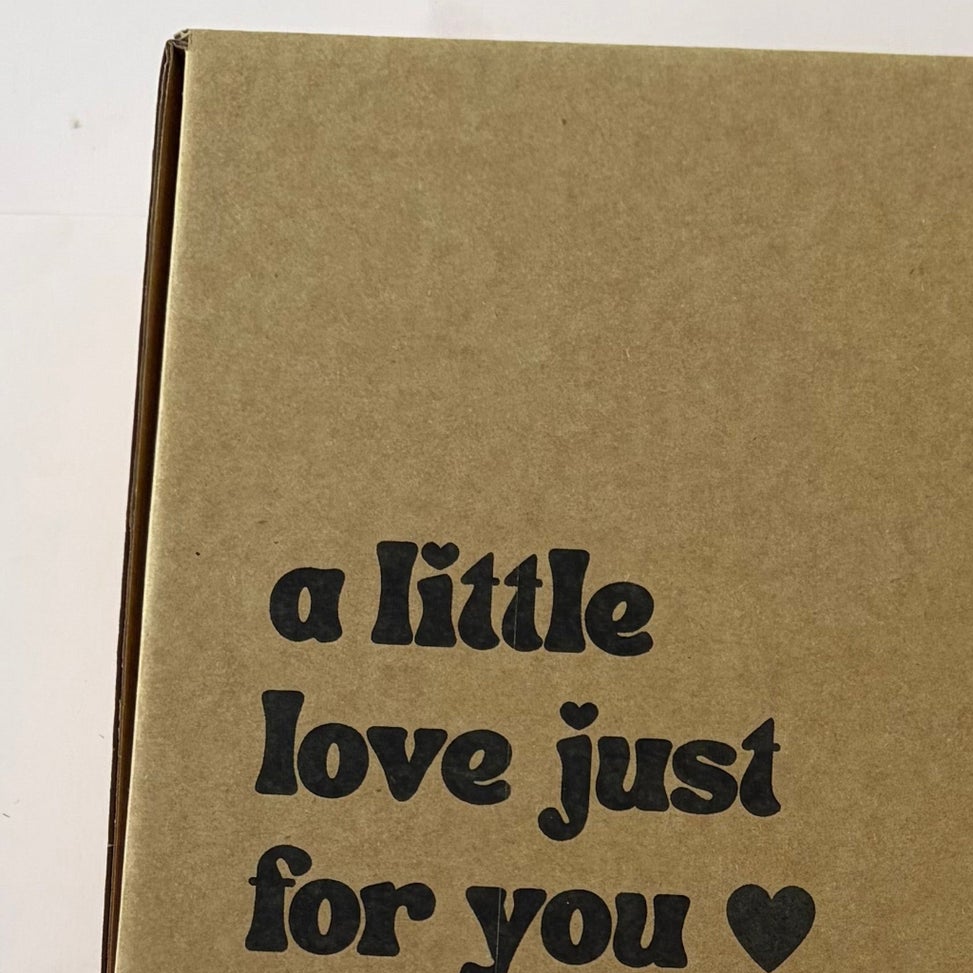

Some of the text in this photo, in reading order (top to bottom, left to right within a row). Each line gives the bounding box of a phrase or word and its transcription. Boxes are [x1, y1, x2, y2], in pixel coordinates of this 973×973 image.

[269, 541, 655, 657] a little
[254, 690, 782, 842] love just
[245, 844, 436, 957] for
